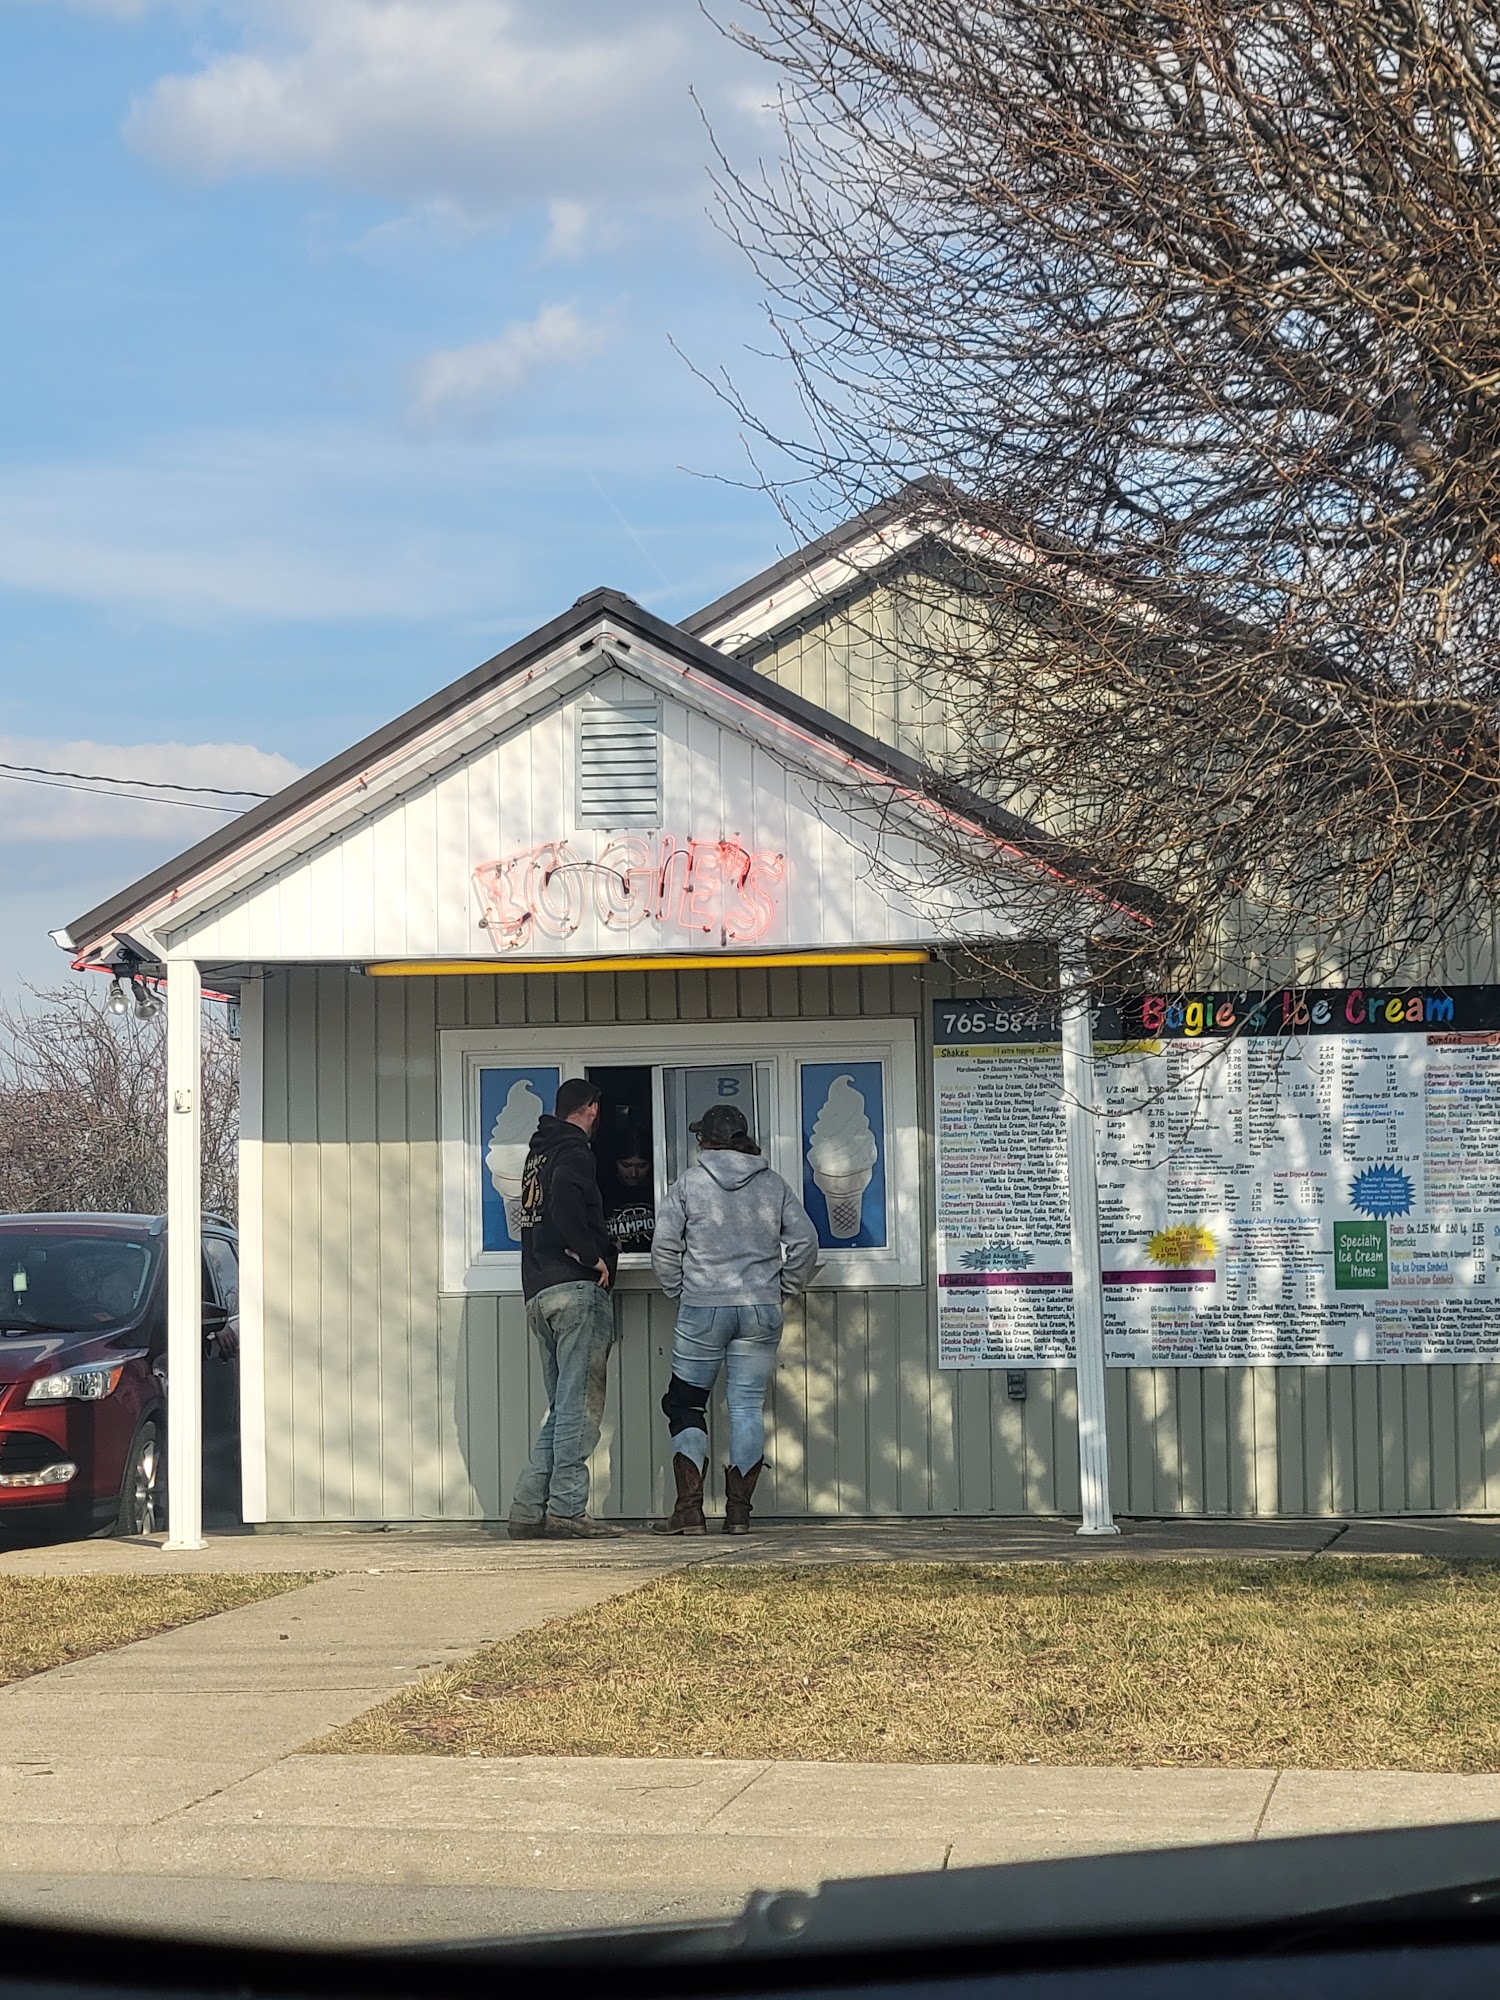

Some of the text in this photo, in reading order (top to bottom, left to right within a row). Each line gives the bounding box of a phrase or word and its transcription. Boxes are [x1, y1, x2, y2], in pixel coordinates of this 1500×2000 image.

[1143, 990, 1454, 1037] Bogie's Ice Cream
[1428, 1036, 1461, 1044] Sundaes
[941, 1049, 969, 1057] Shakes
[1390, 1224, 1404, 1234] Floats
[1417, 1224, 1429, 1233] 2.25
[1446, 1223, 1457, 1233] 2.60
[1340, 1235, 1381, 1248] Specialty
[1390, 1238, 1416, 1247] Drumsticks
[1339, 1250, 1350, 1262] Ice
[1355, 1250, 1383, 1262] Cream
[1351, 1266, 1376, 1277] Items
[1391, 1262, 1485, 1272] Reg. Ice Cream Sandwich 1.75
[1391, 1275, 1406, 1285] Cookie
[1416, 1275, 1431, 1285] Cream
[1433, 1274, 1453, 1285] Sandwich
